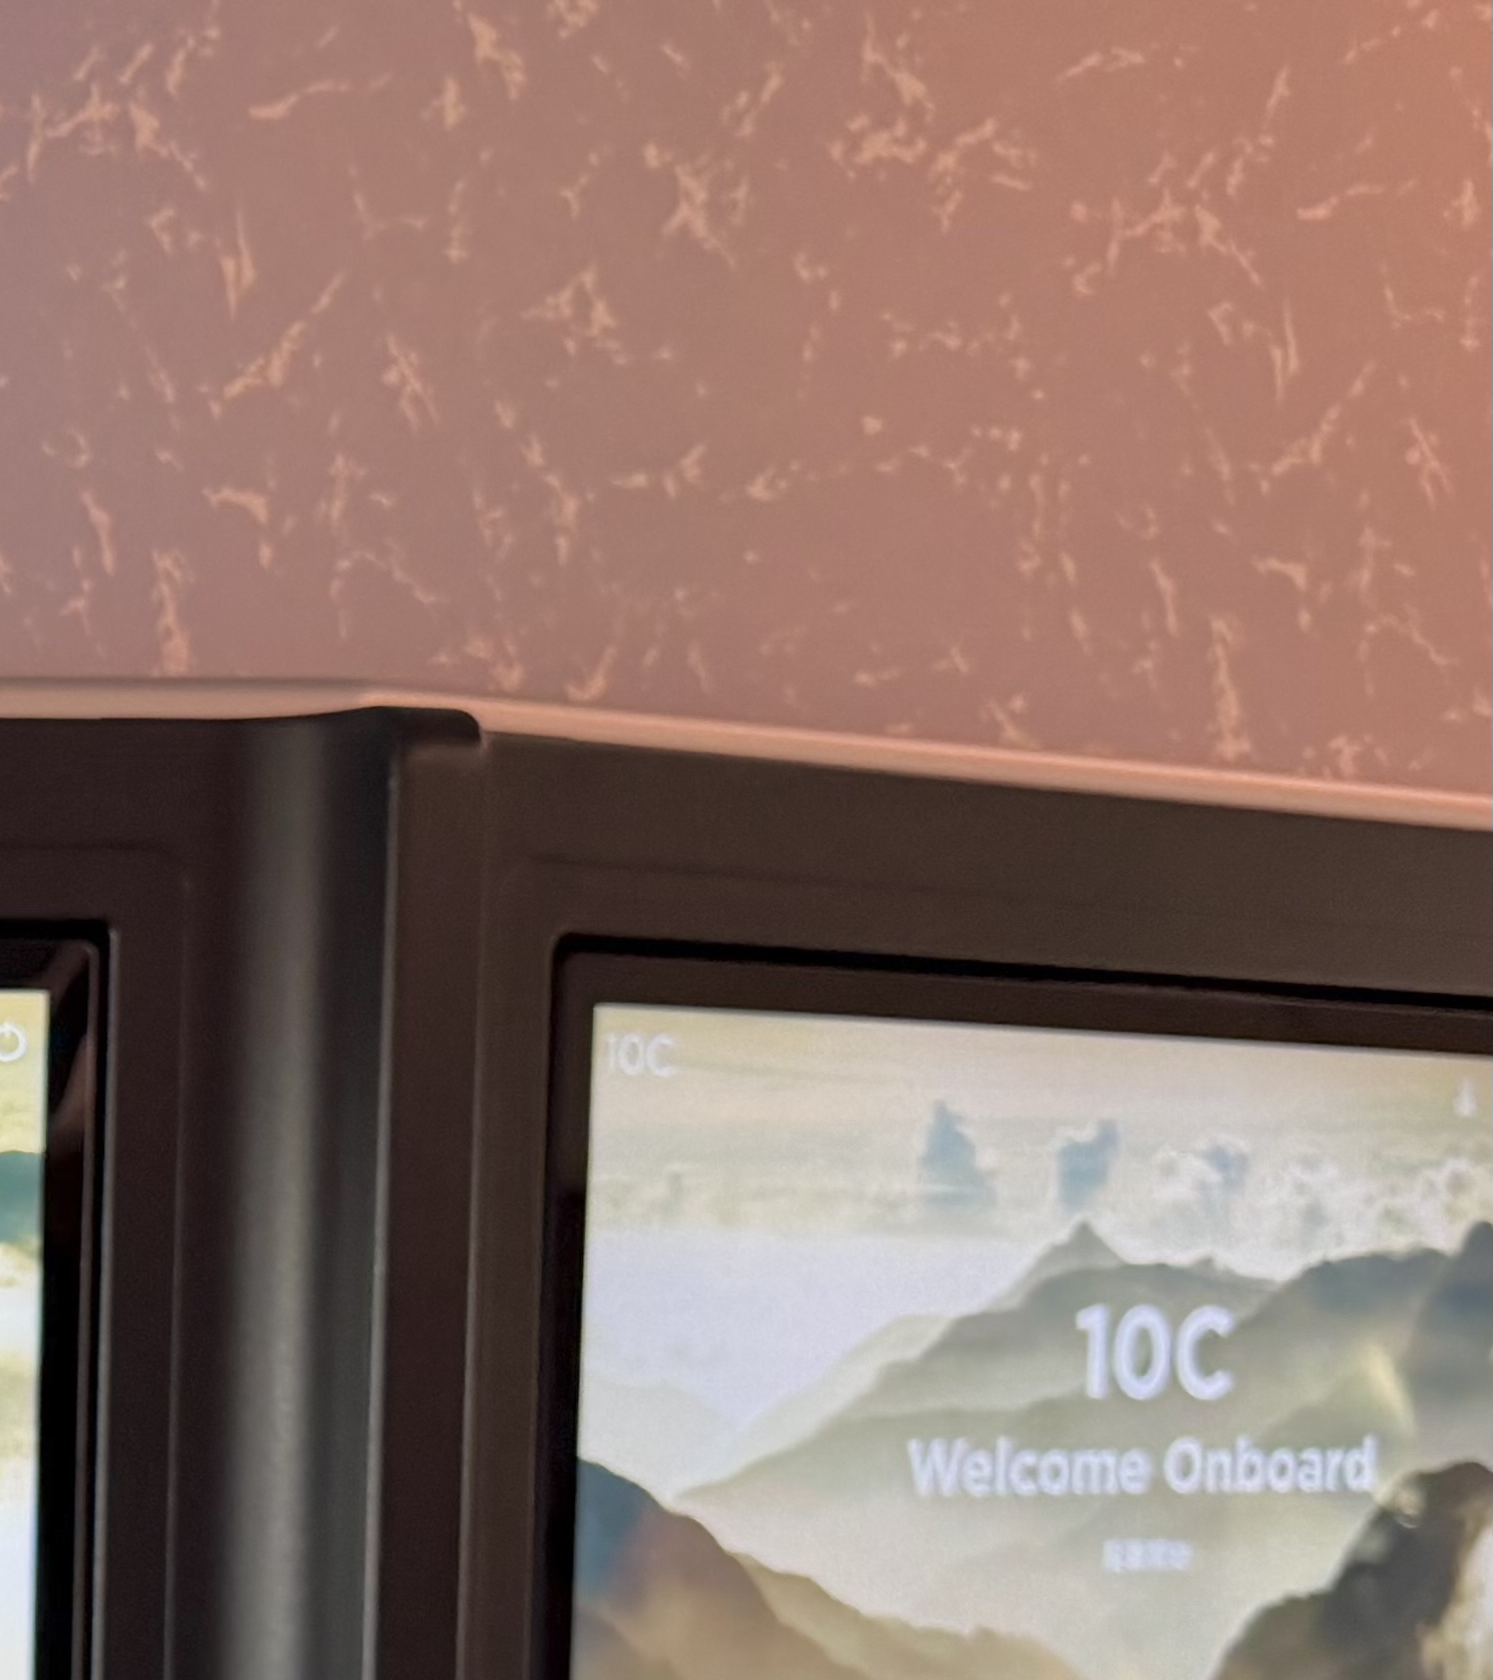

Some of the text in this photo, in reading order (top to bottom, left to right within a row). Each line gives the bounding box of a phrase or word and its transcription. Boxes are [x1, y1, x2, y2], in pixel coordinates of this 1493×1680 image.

[604, 1032, 678, 1078] 10C
[1074, 1304, 1236, 1401] 10C
[907, 1434, 1380, 1497] Welcome Onboard
